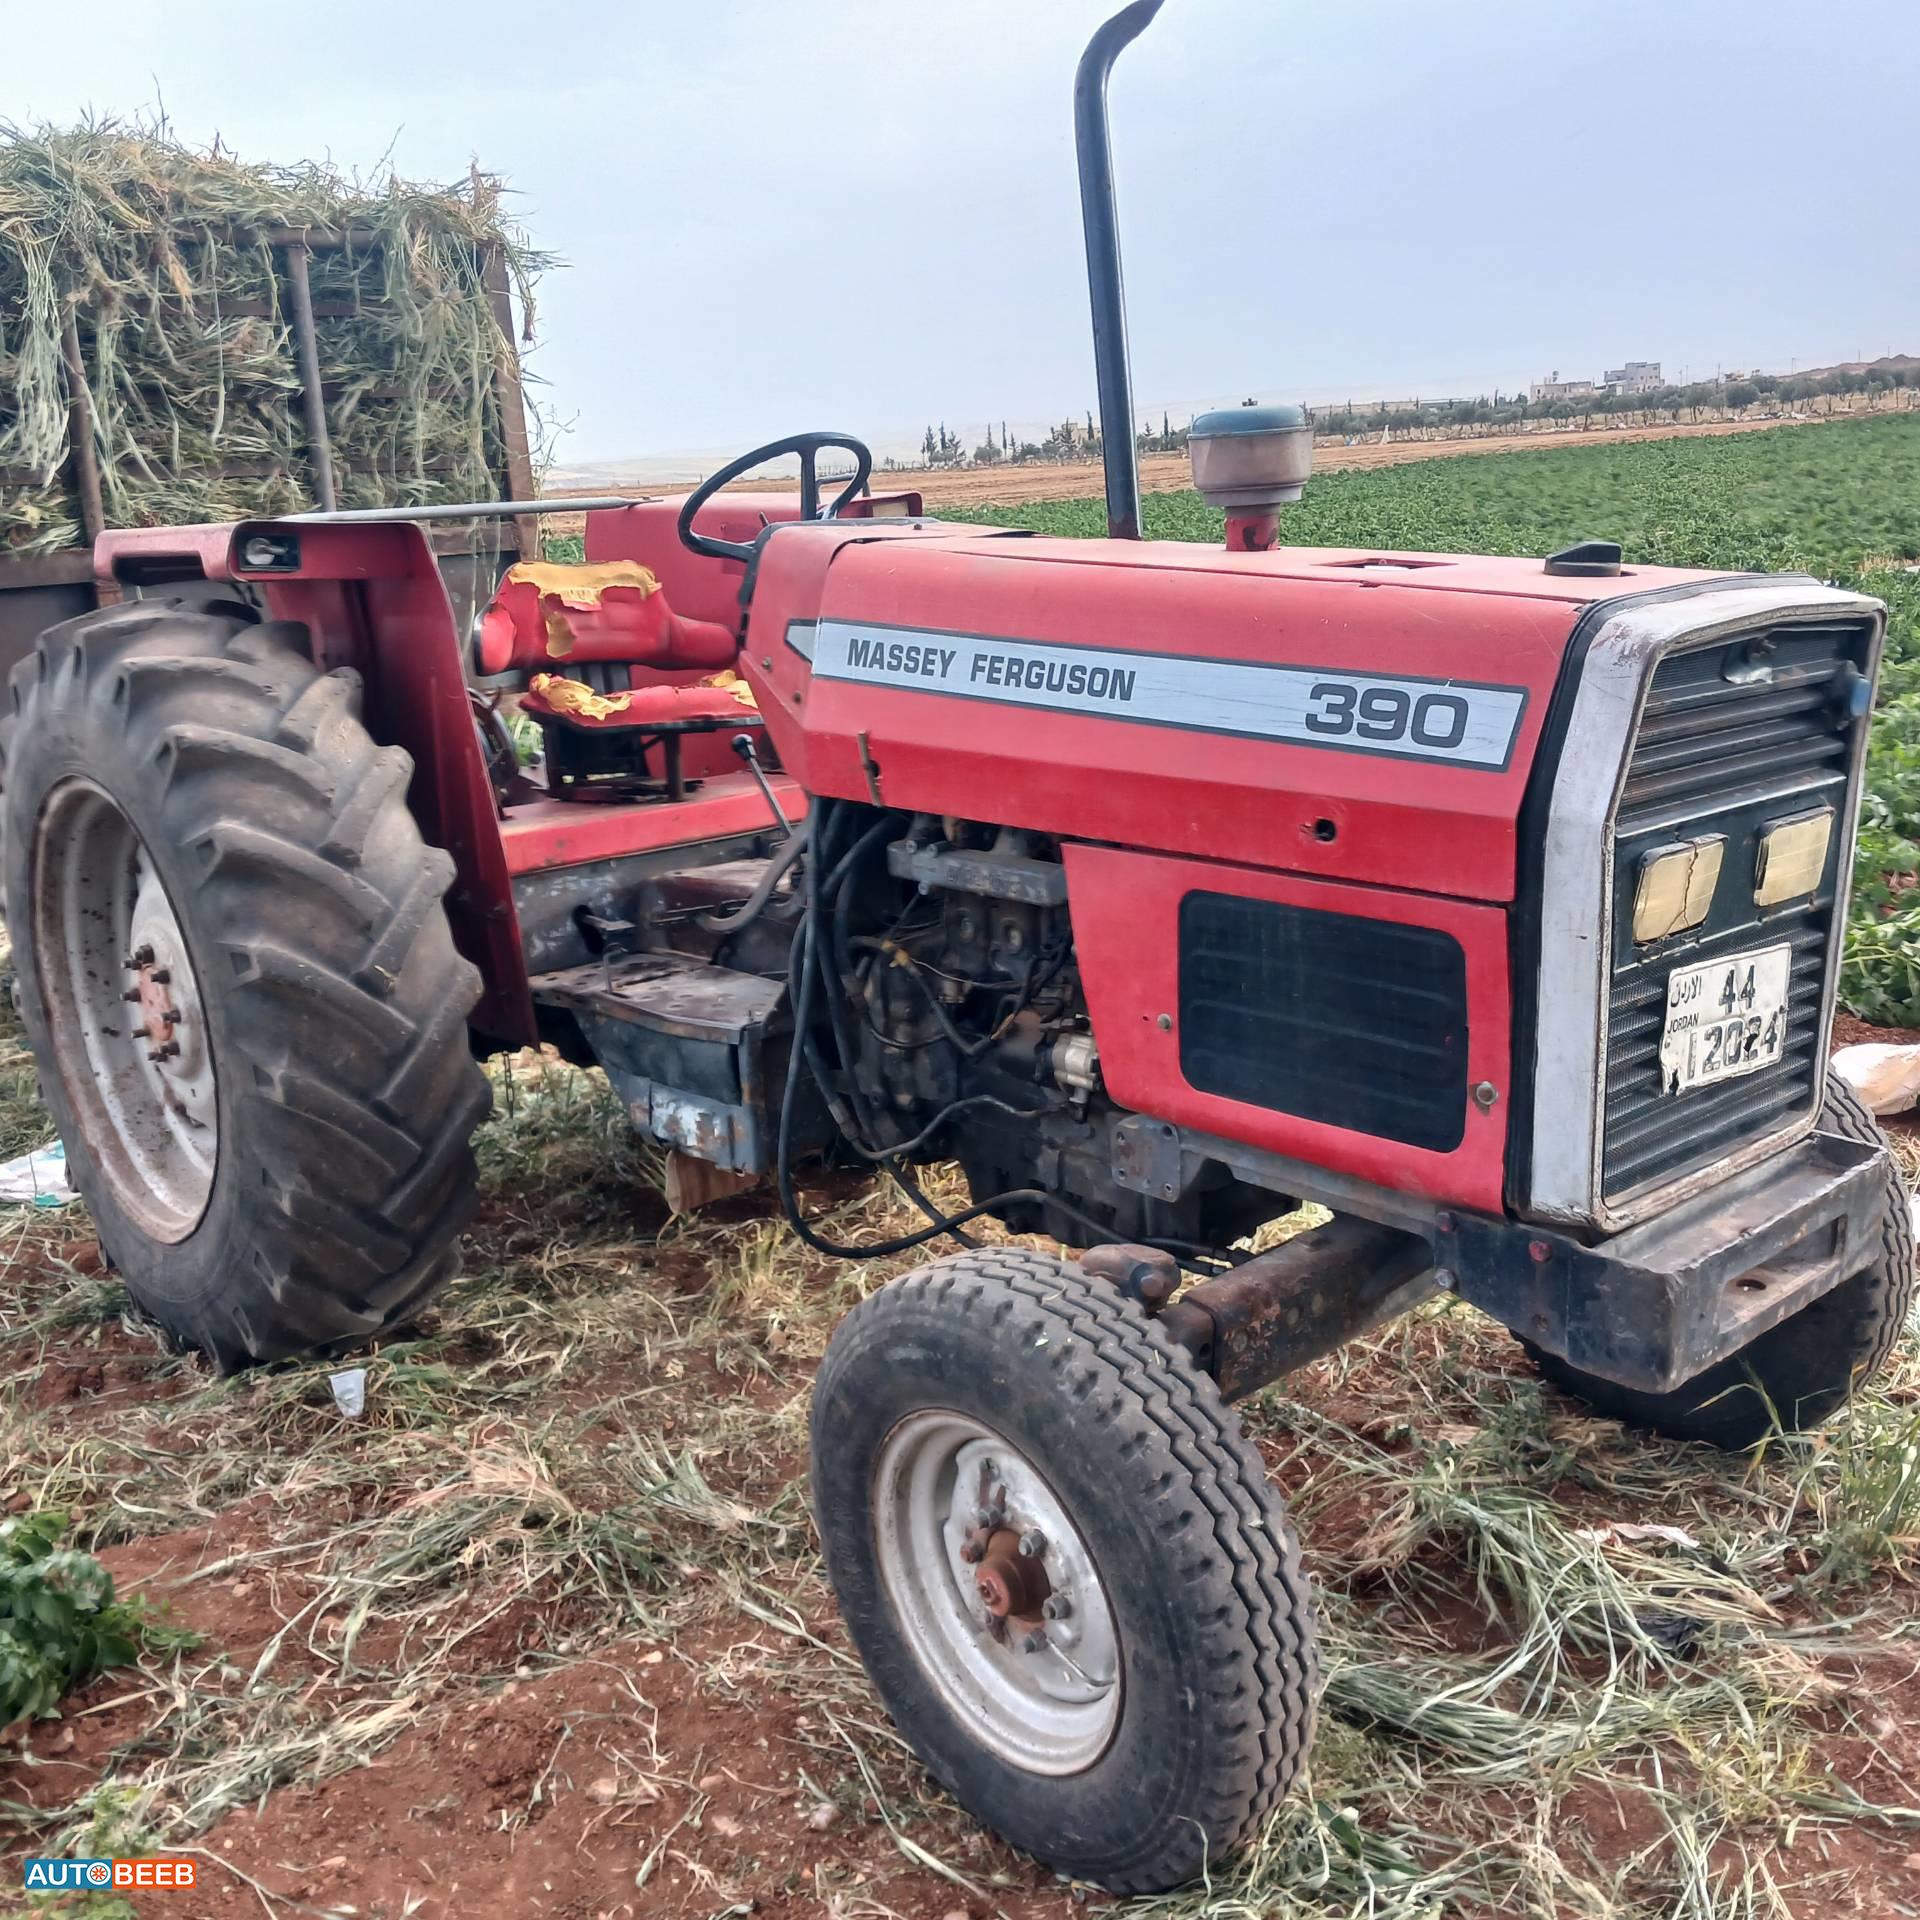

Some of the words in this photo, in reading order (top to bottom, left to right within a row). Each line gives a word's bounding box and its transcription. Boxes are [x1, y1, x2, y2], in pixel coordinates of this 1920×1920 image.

[847, 638, 956, 678] MASSEY
[970, 653, 1136, 701] FERGUSON
[1305, 683, 1469, 749] 390
[1718, 964, 1756, 1016] 44
[1667, 1012, 1700, 1034] JORDAN
